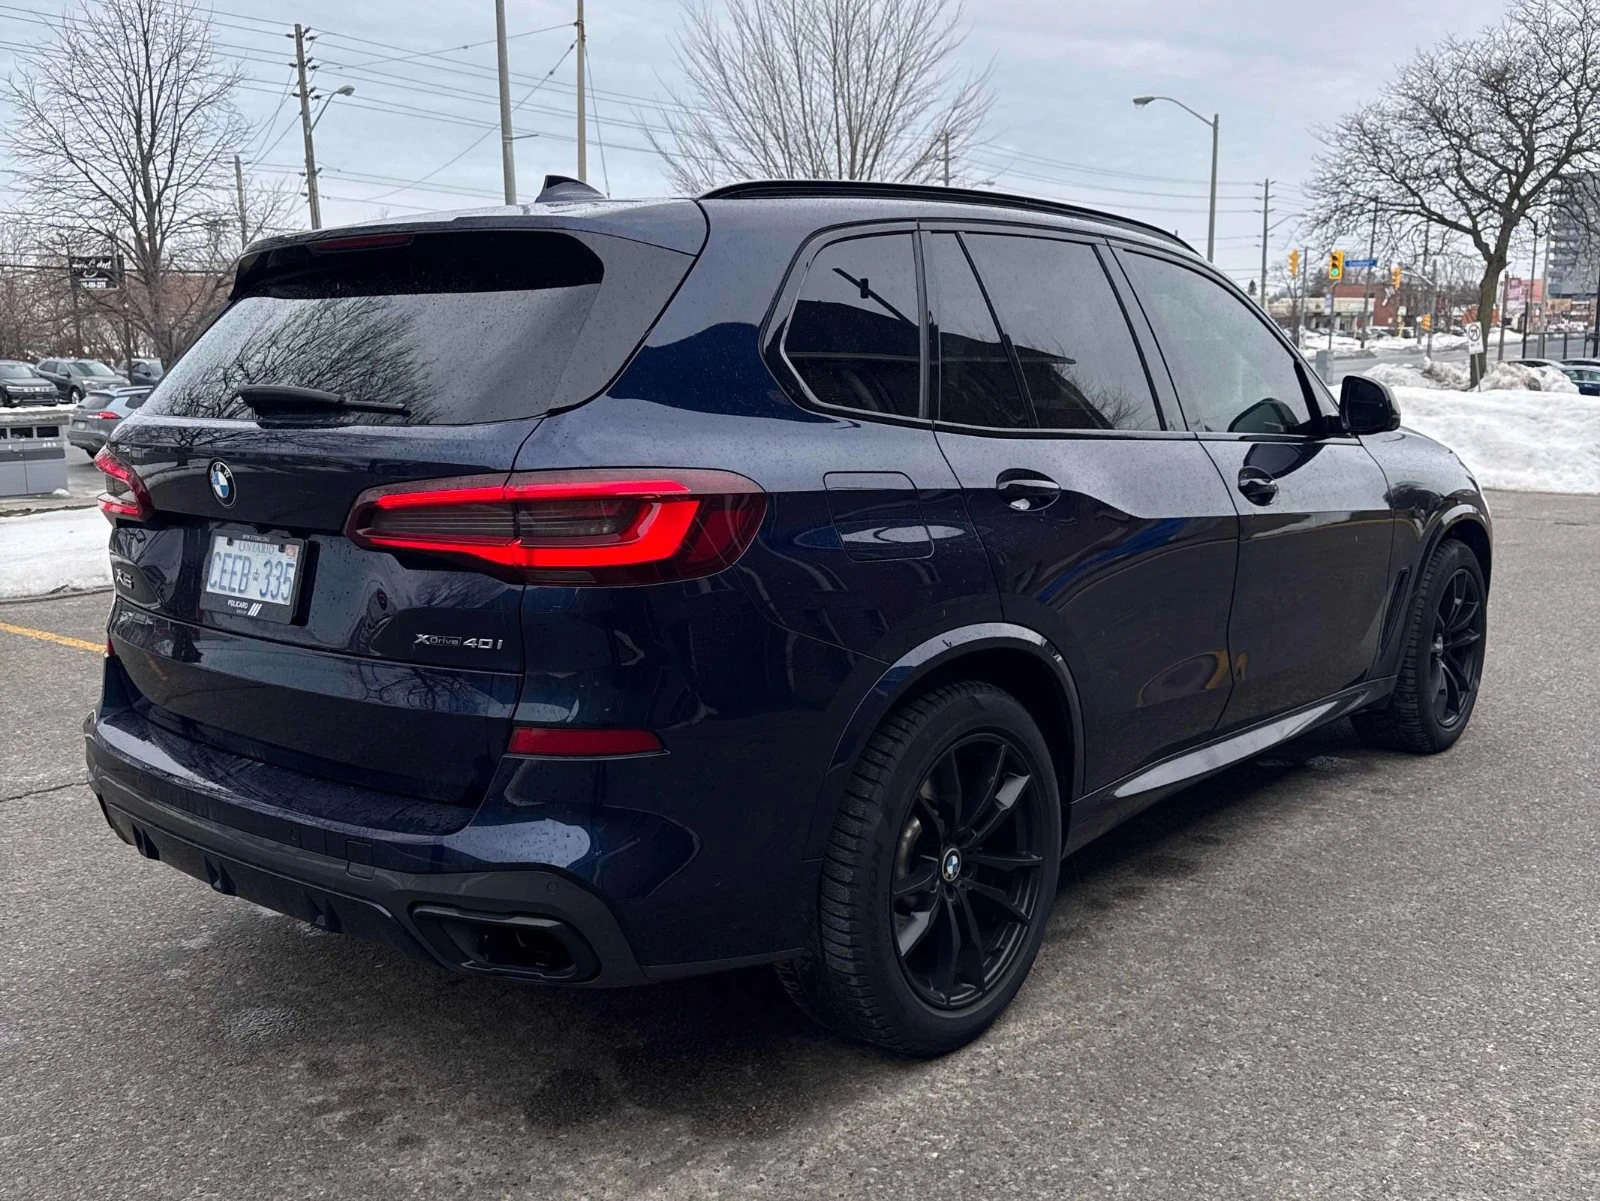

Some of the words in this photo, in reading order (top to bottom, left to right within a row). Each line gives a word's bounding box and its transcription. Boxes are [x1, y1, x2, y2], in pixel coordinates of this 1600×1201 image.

[239, 541, 275, 555] ONTARIO
[115, 567, 133, 590] X5
[208, 551, 252, 594] CEEB
[260, 560, 295, 601] 335
